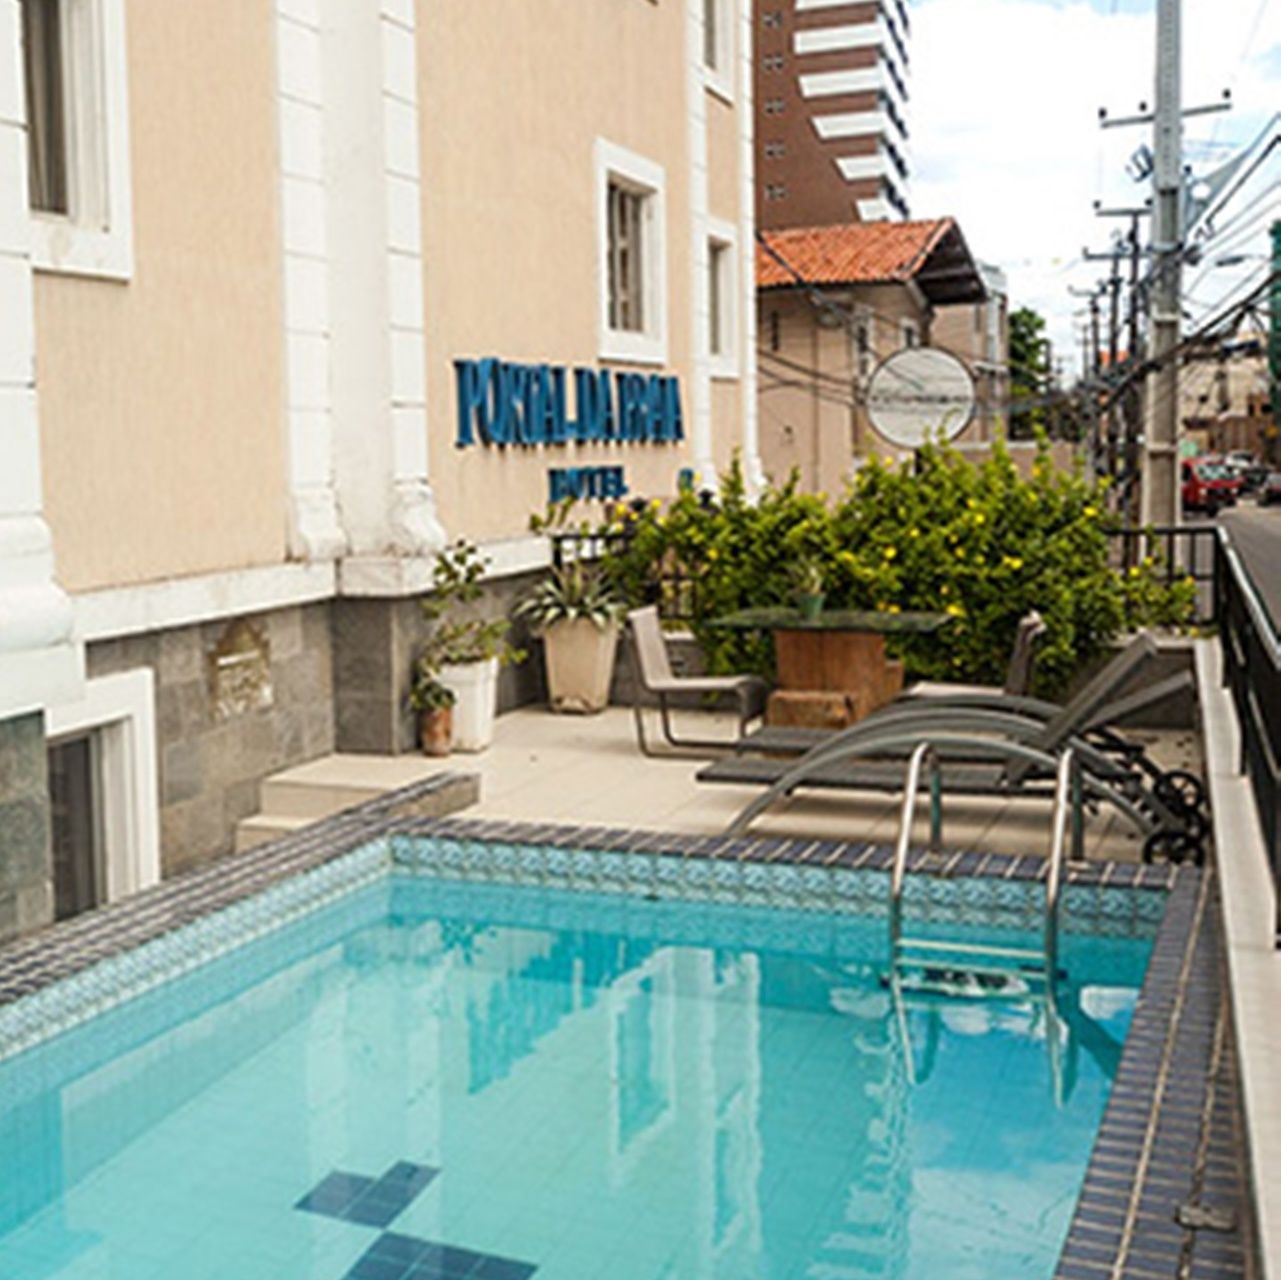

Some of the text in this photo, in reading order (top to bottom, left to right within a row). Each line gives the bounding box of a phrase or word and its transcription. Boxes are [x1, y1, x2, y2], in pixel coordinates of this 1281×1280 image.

[453, 358, 575, 448] PORTAL
[574, 368, 615, 444] DA
[547, 466, 629, 502] HOTEL
